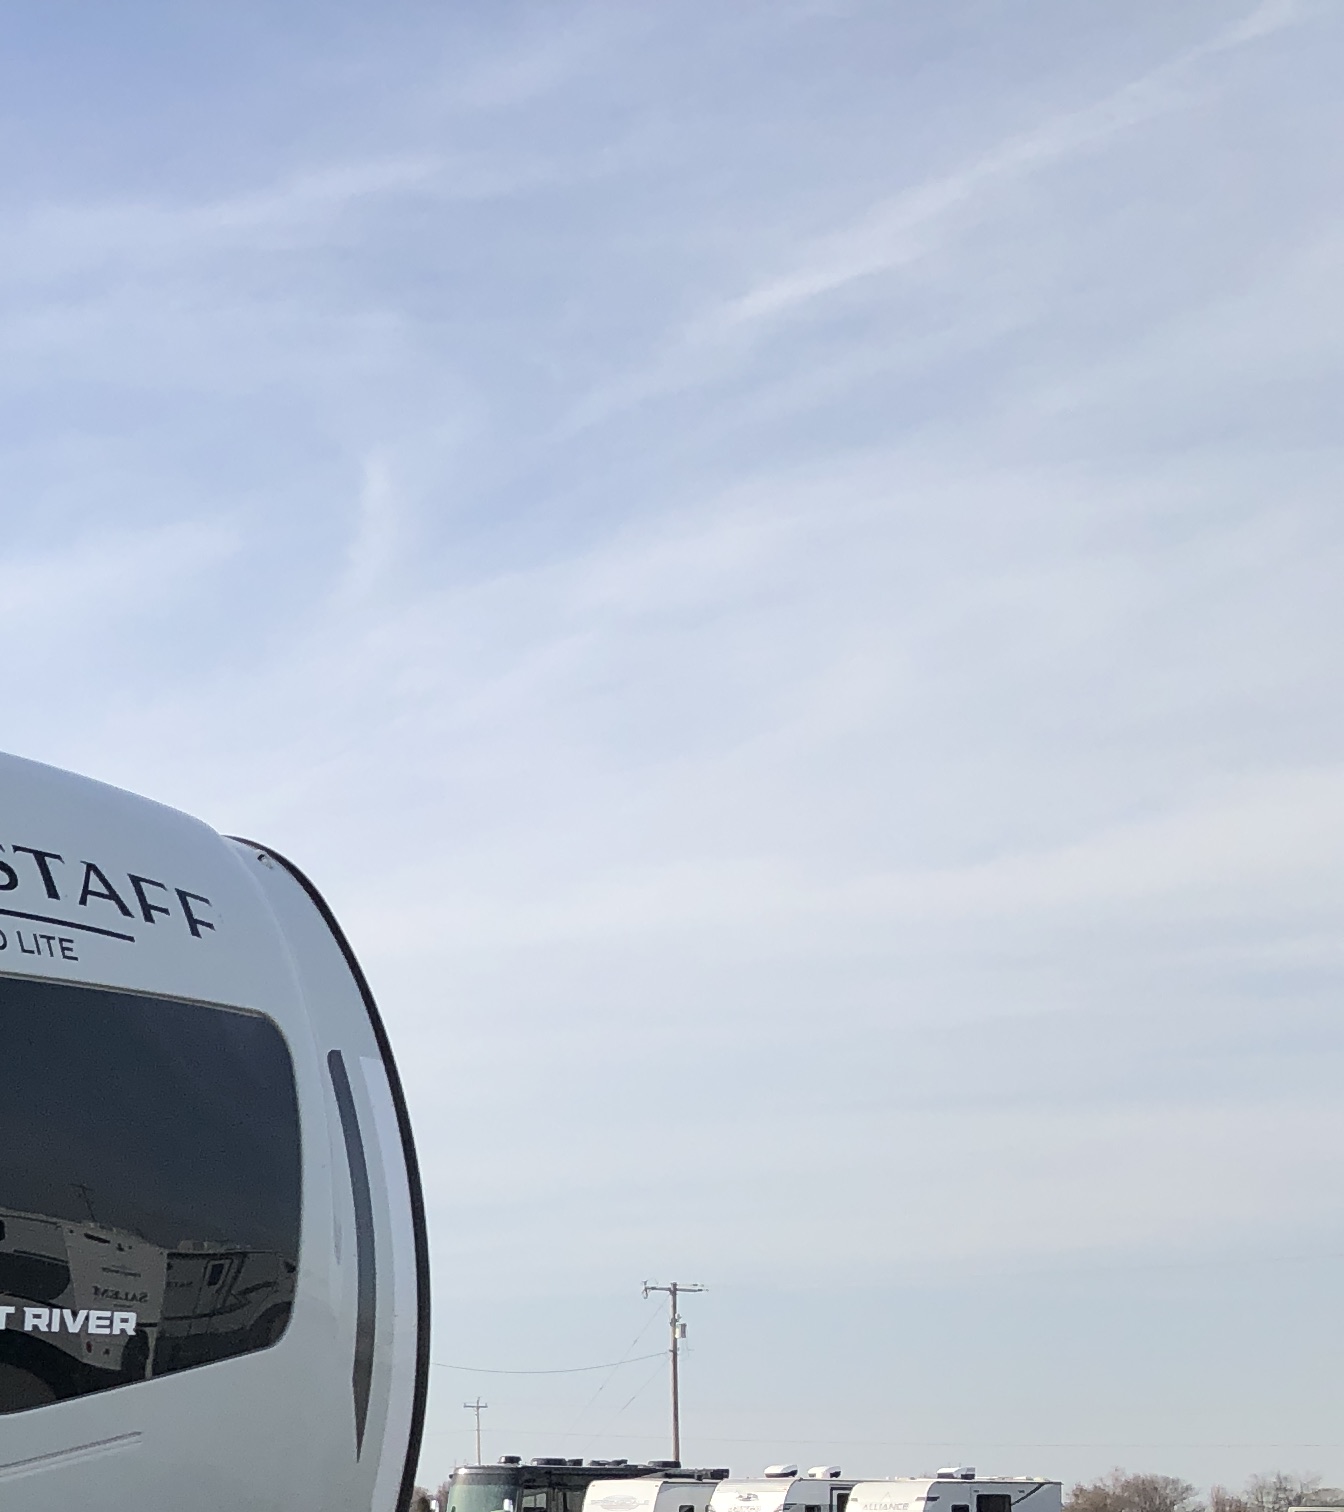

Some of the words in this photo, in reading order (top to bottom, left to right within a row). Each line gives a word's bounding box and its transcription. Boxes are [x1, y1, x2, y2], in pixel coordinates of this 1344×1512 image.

[16, 930, 79, 962] LITE
[22, 1306, 138, 1336] RIVER
[862, 1502, 910, 1511] ALLIANCE
